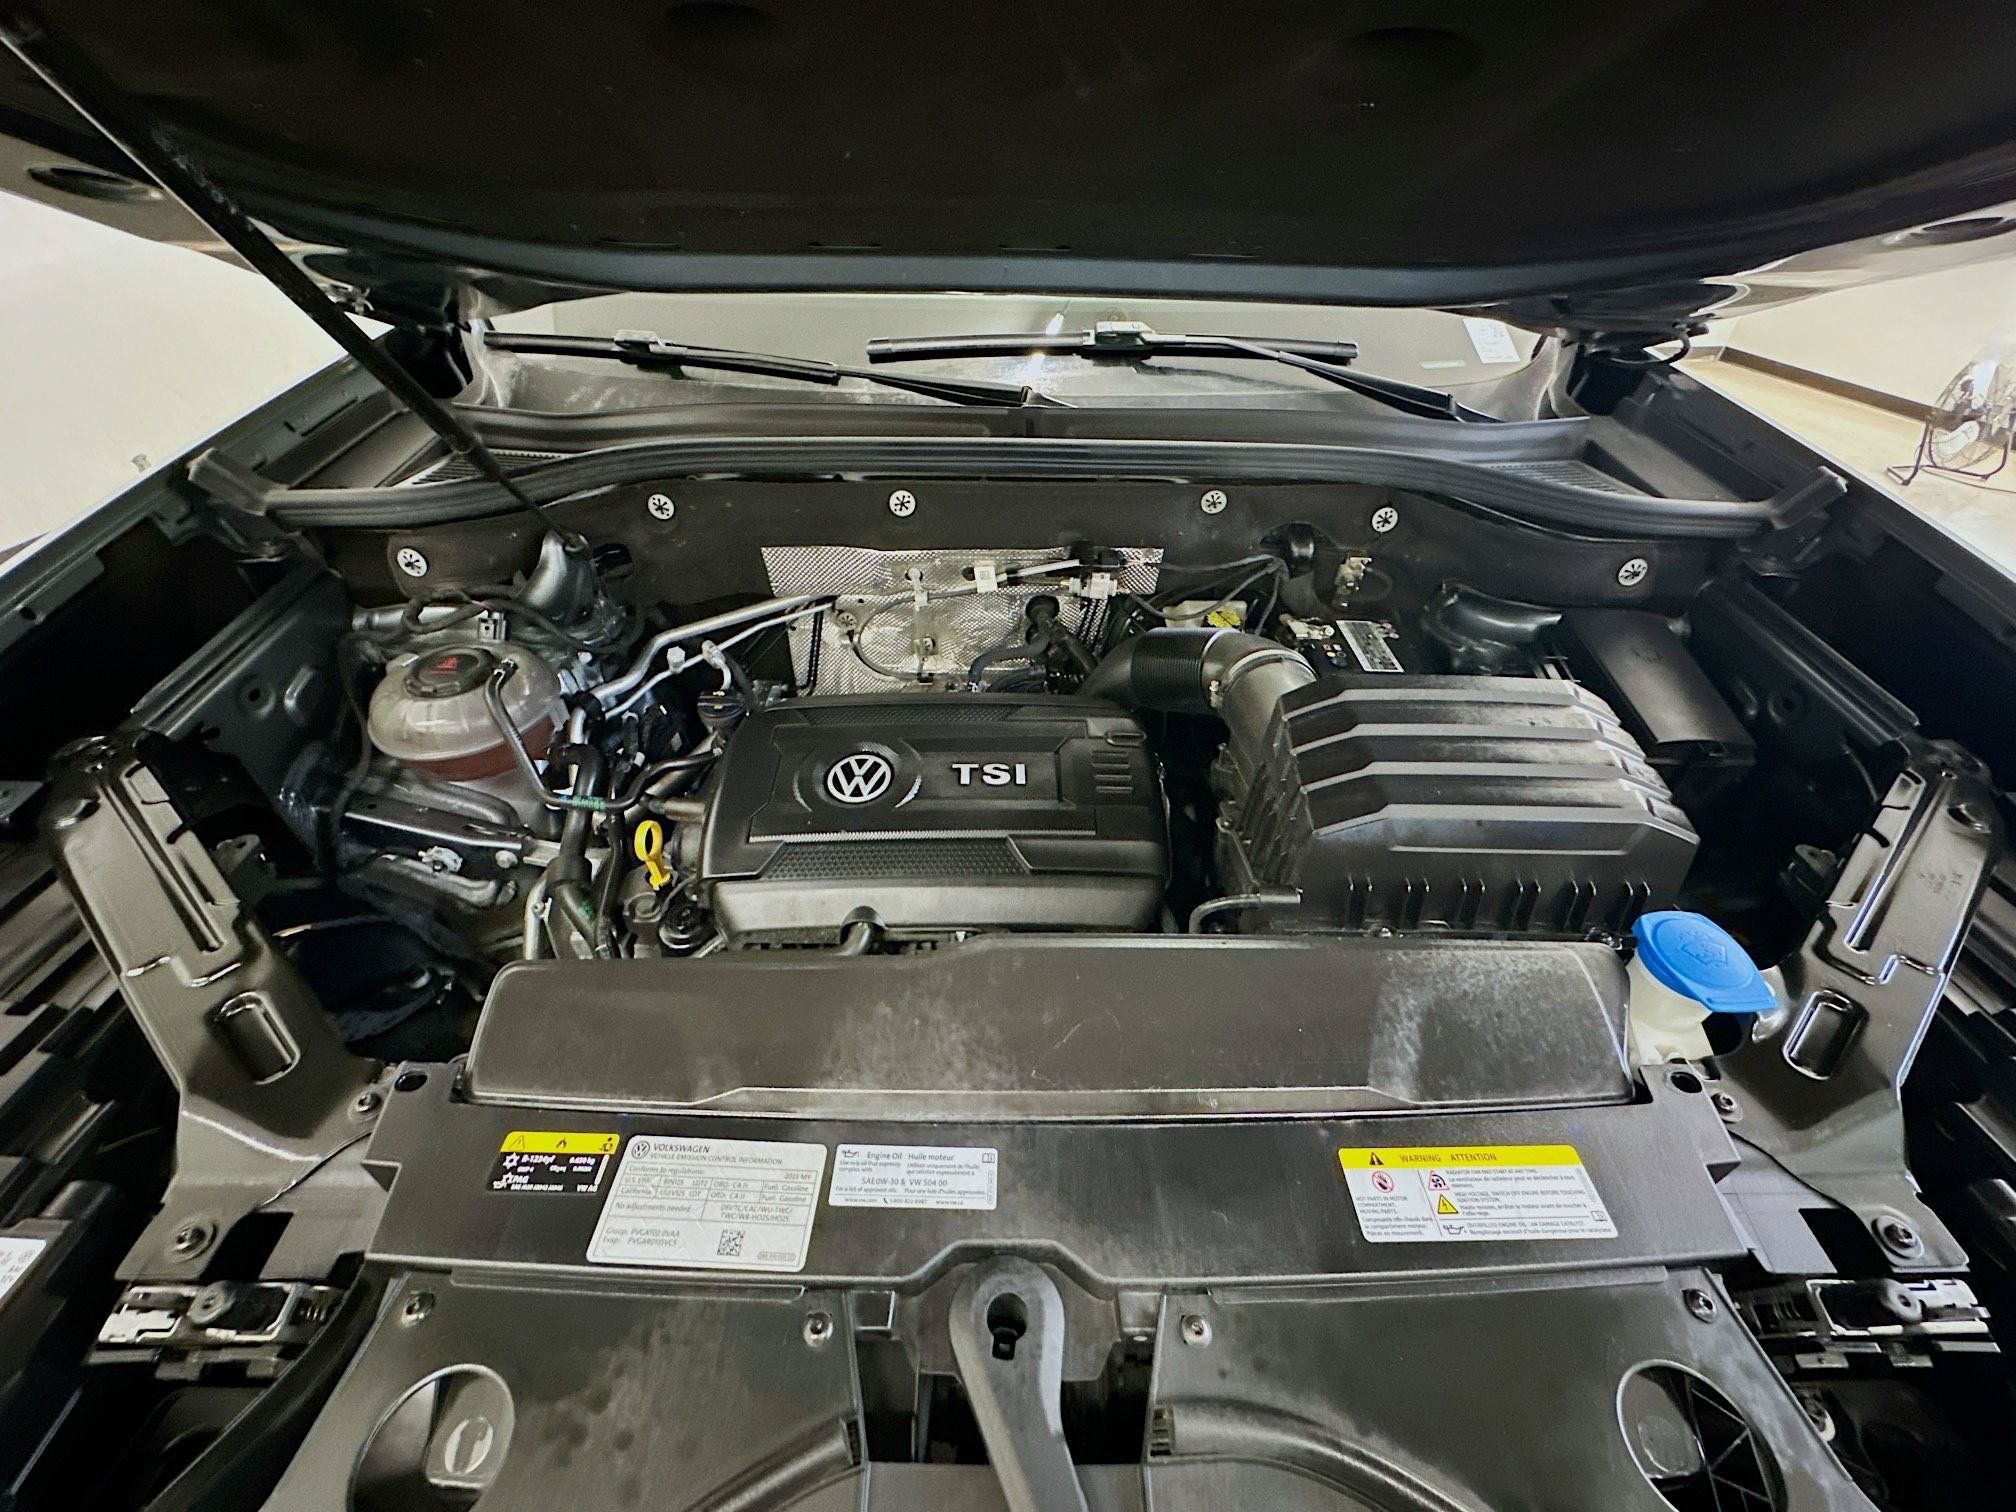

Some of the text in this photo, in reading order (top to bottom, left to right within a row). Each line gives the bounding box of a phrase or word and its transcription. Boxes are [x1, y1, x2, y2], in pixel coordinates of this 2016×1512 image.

[952, 763, 1026, 785] TSI
[653, 1143, 711, 1153] VOLKSWAGEN
[650, 1152, 783, 1165] VEHICLE EMISSION CONTROL INFORMATION
[867, 1151, 902, 1160] Engine Oil
[908, 1152, 954, 1161] Huile moteur
[1399, 1152, 1498, 1163] WARNING ATTENTION
[909, 1179, 922, 1187] VW
[923, 1178, 937, 1187] 504
[781, 1184, 809, 1193] Gasoline
[779, 1194, 807, 1203] Gasoline
[667, 1204, 692, 1212] needed
